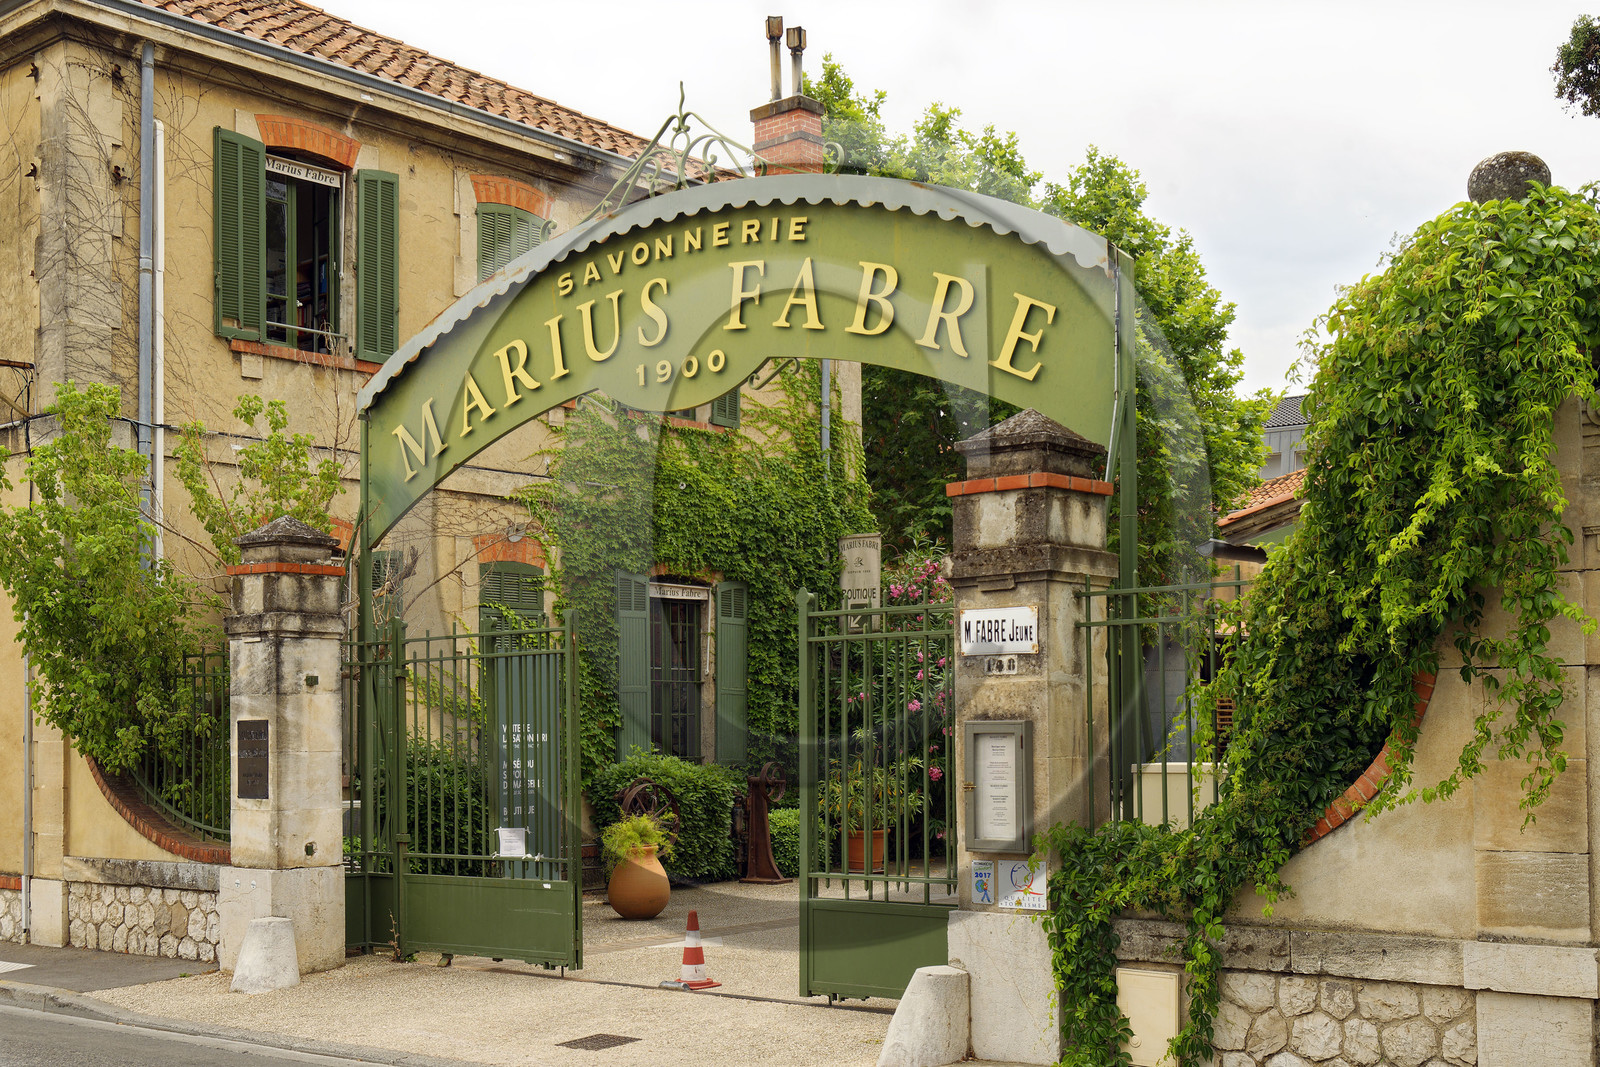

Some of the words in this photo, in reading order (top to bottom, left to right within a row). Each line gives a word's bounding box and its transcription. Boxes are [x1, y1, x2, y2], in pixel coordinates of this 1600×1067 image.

[266, 158, 302, 176] Marius
[305, 168, 335, 184] Fabre
[557, 216, 808, 297] SAVONNERIE
[391, 276, 669, 483] MARIUS
[723, 257, 1057, 381] FABRE
[635, 349, 726, 387] 1900
[840, 540, 861, 552] MARIUS
[862, 540, 879, 550] FABRE
[655, 586, 680, 596] Marius
[682, 588, 701, 597] Fabre
[964, 620, 975, 643] M.
[976, 619, 1006, 642] FABRE
[1009, 619, 1033, 642] JEUNE
